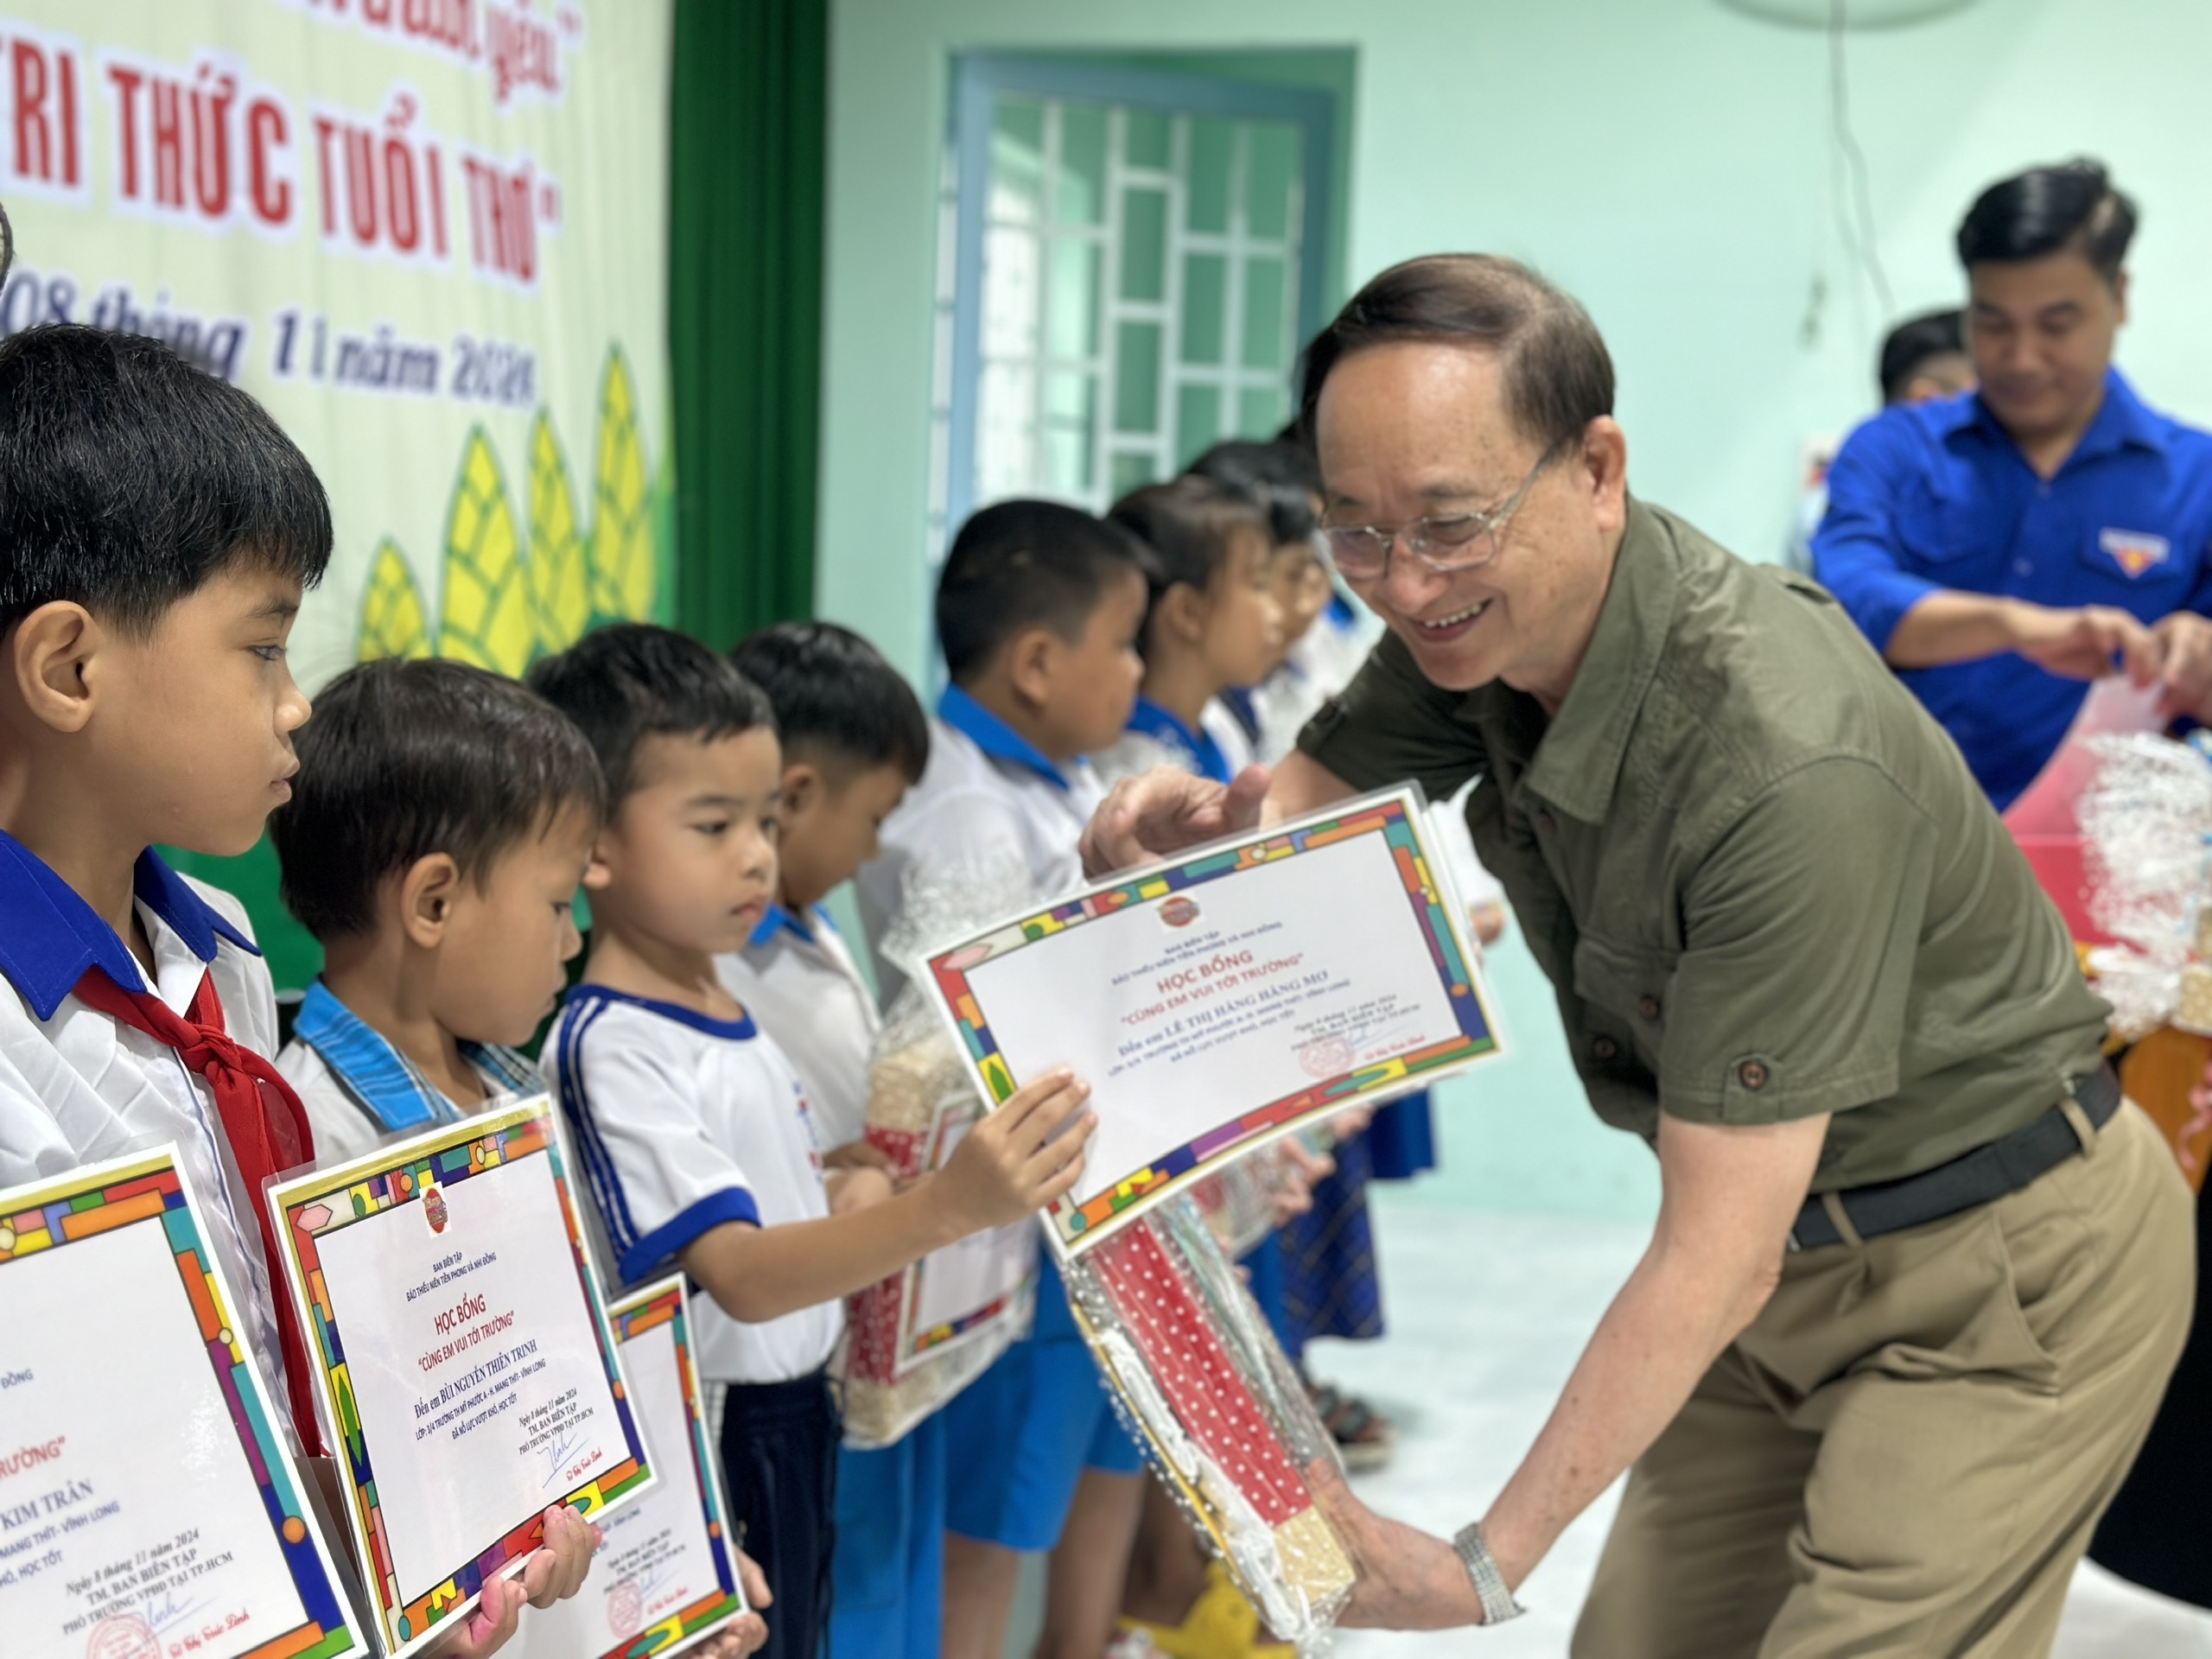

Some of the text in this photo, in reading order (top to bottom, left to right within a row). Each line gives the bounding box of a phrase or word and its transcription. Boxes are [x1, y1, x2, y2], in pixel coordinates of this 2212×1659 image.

[0, 36, 81, 188] RI
[105, 61, 292, 223] THỨC
[313, 91, 448, 257] TUỔI
[335, 325, 439, 393] năm
[1157, 969, 1198, 994] HỌC
[406, 1288, 417, 1301] BÁO
[450, 1266, 467, 1281] PHONG
[433, 1261, 443, 1273] BAN
[443, 1255, 454, 1268] BIÊN
[434, 1293, 486, 1336] HỌC BỔNG
[442, 1342, 455, 1360] EM
[454, 1335, 468, 1353] VUI
[467, 1326, 481, 1347] TỚI
[415, 1339, 537, 1419] Đến em BÙI NGUYỄN THIÊN TRINH
[426, 1422, 435, 1435] 3/4
[434, 1410, 454, 1429] TRƯỜNG
[454, 1407, 461, 1418] TH
[494, 1378, 509, 1394] MANG
[531, 1358, 546, 1372] LONG
[565, 1387, 577, 1401] 2024
[499, 1397, 510, 1411] HỌC
[538, 1417, 551, 1431] BAN
[552, 1408, 566, 1423] BIÊN
[574, 1407, 594, 1424] TP.HCM
[0, 1435, 65, 1479] RƯỜNG”
[0, 1479, 93, 1530] KIM TRÂN
[0, 1536, 33, 1560] MANG
[90, 1501, 120, 1522] LONG
[0, 1548, 63, 1587] HÓ, HỌC TỐT
[66, 1576, 92, 1596] Ngày
[103, 1559, 133, 1580] tháng
[149, 1542, 173, 1559] năm
[175, 1528, 200, 1548] 2024
[86, 1548, 197, 1606] TM. BAN BIÊN TẬP
[63, 1614, 87, 1635] PHÓ
[168, 1570, 189, 1589] TẠI
[189, 1551, 233, 1578] TP.HCM
